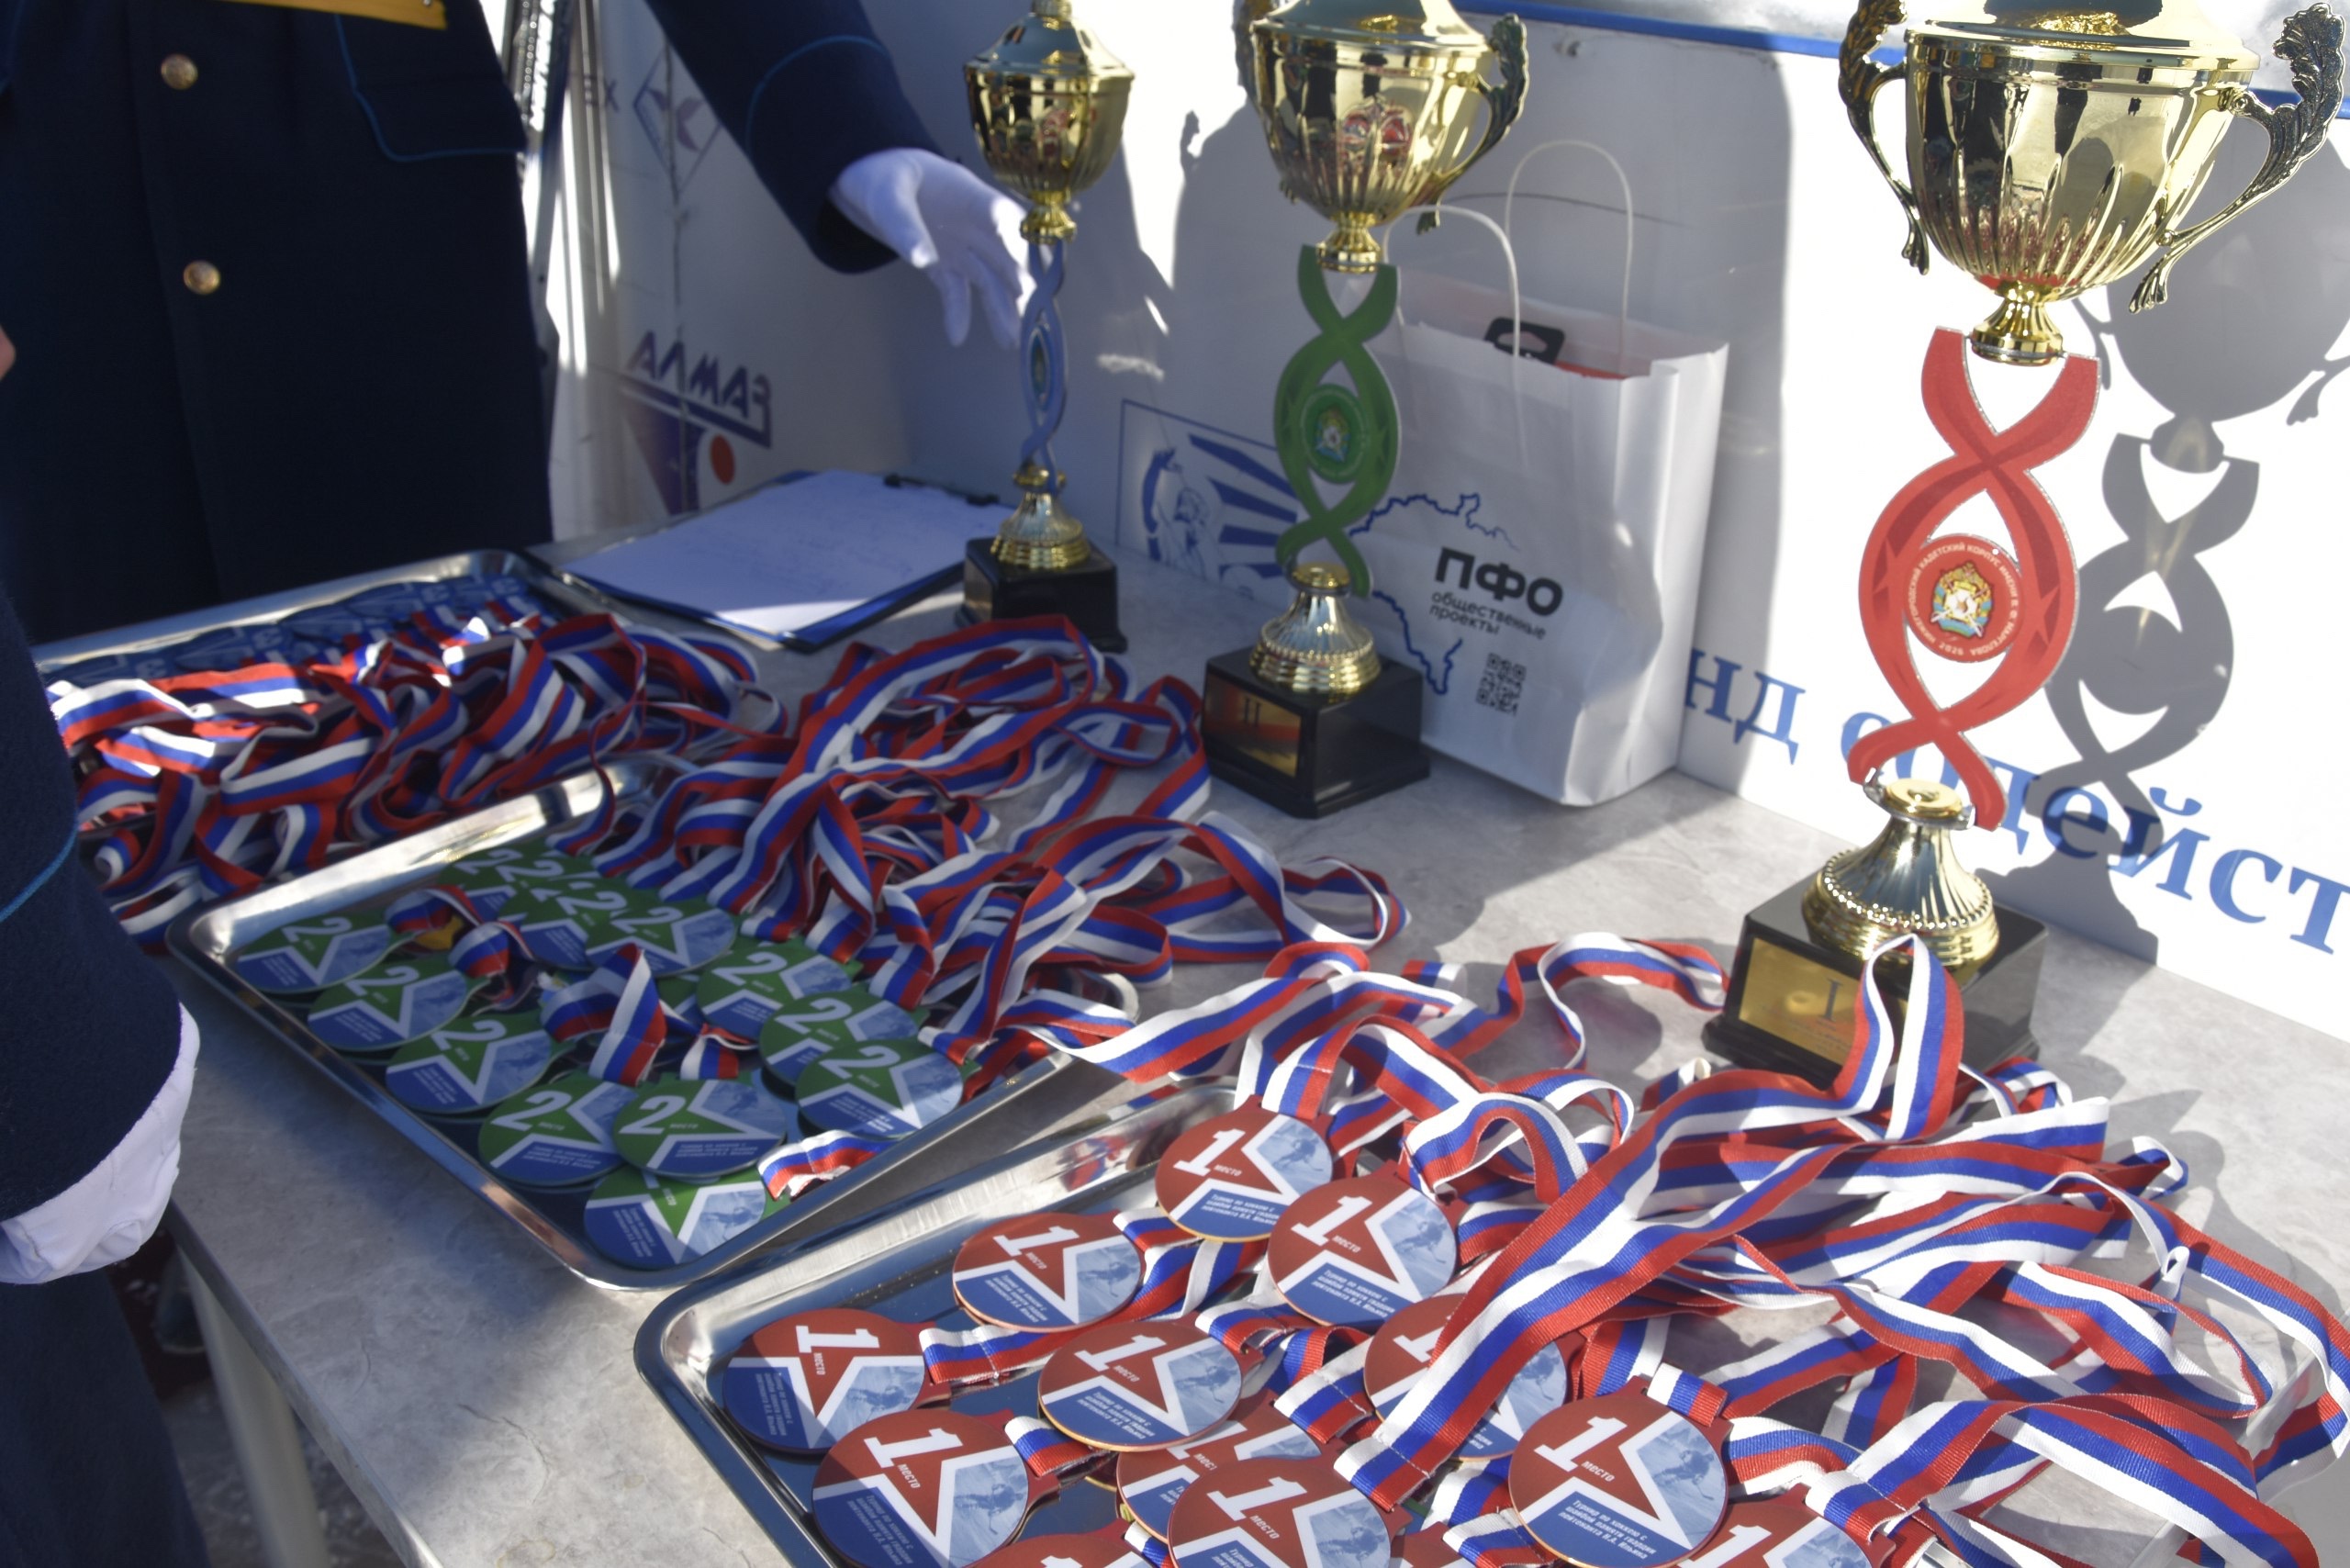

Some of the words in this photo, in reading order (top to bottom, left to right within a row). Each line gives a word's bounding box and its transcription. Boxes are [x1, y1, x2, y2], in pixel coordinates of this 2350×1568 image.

[1435, 546, 1563, 617] ПФО
[1429, 604, 1500, 635] проекты
[1431, 591, 1546, 640] общественные
[496, 860, 564, 882] 2
[556, 891, 627, 915] 2
[283, 917, 352, 943] 2
[610, 907, 683, 933] 2
[344, 966, 420, 996] 2
[712, 951, 788, 986] 2
[775, 998, 852, 1035] 2
[431, 1020, 507, 1051] 2
[819, 1046, 901, 1079] 2
[490, 1091, 572, 1131] 2
[619, 1095, 687, 1135] 2
[1173, 1128, 1246, 1177] 1
[1213, 1164, 1242, 1177] место
[1291, 1195, 1373, 1247] 1
[992, 1226, 1080, 1257] 1
[1331, 1235, 1361, 1253] место
[795, 1325, 880, 1353] 1
[1074, 1334, 1167, 1372] 1
[1113, 1364, 1141, 1383] место
[863, 1428, 964, 1469] 1
[1533, 1416, 1628, 1473] 1
[1581, 1460, 1616, 1482] место
[897, 1463, 921, 1490] место
[1206, 1476, 1308, 1521] 1
[1249, 1515, 1280, 1540] место
